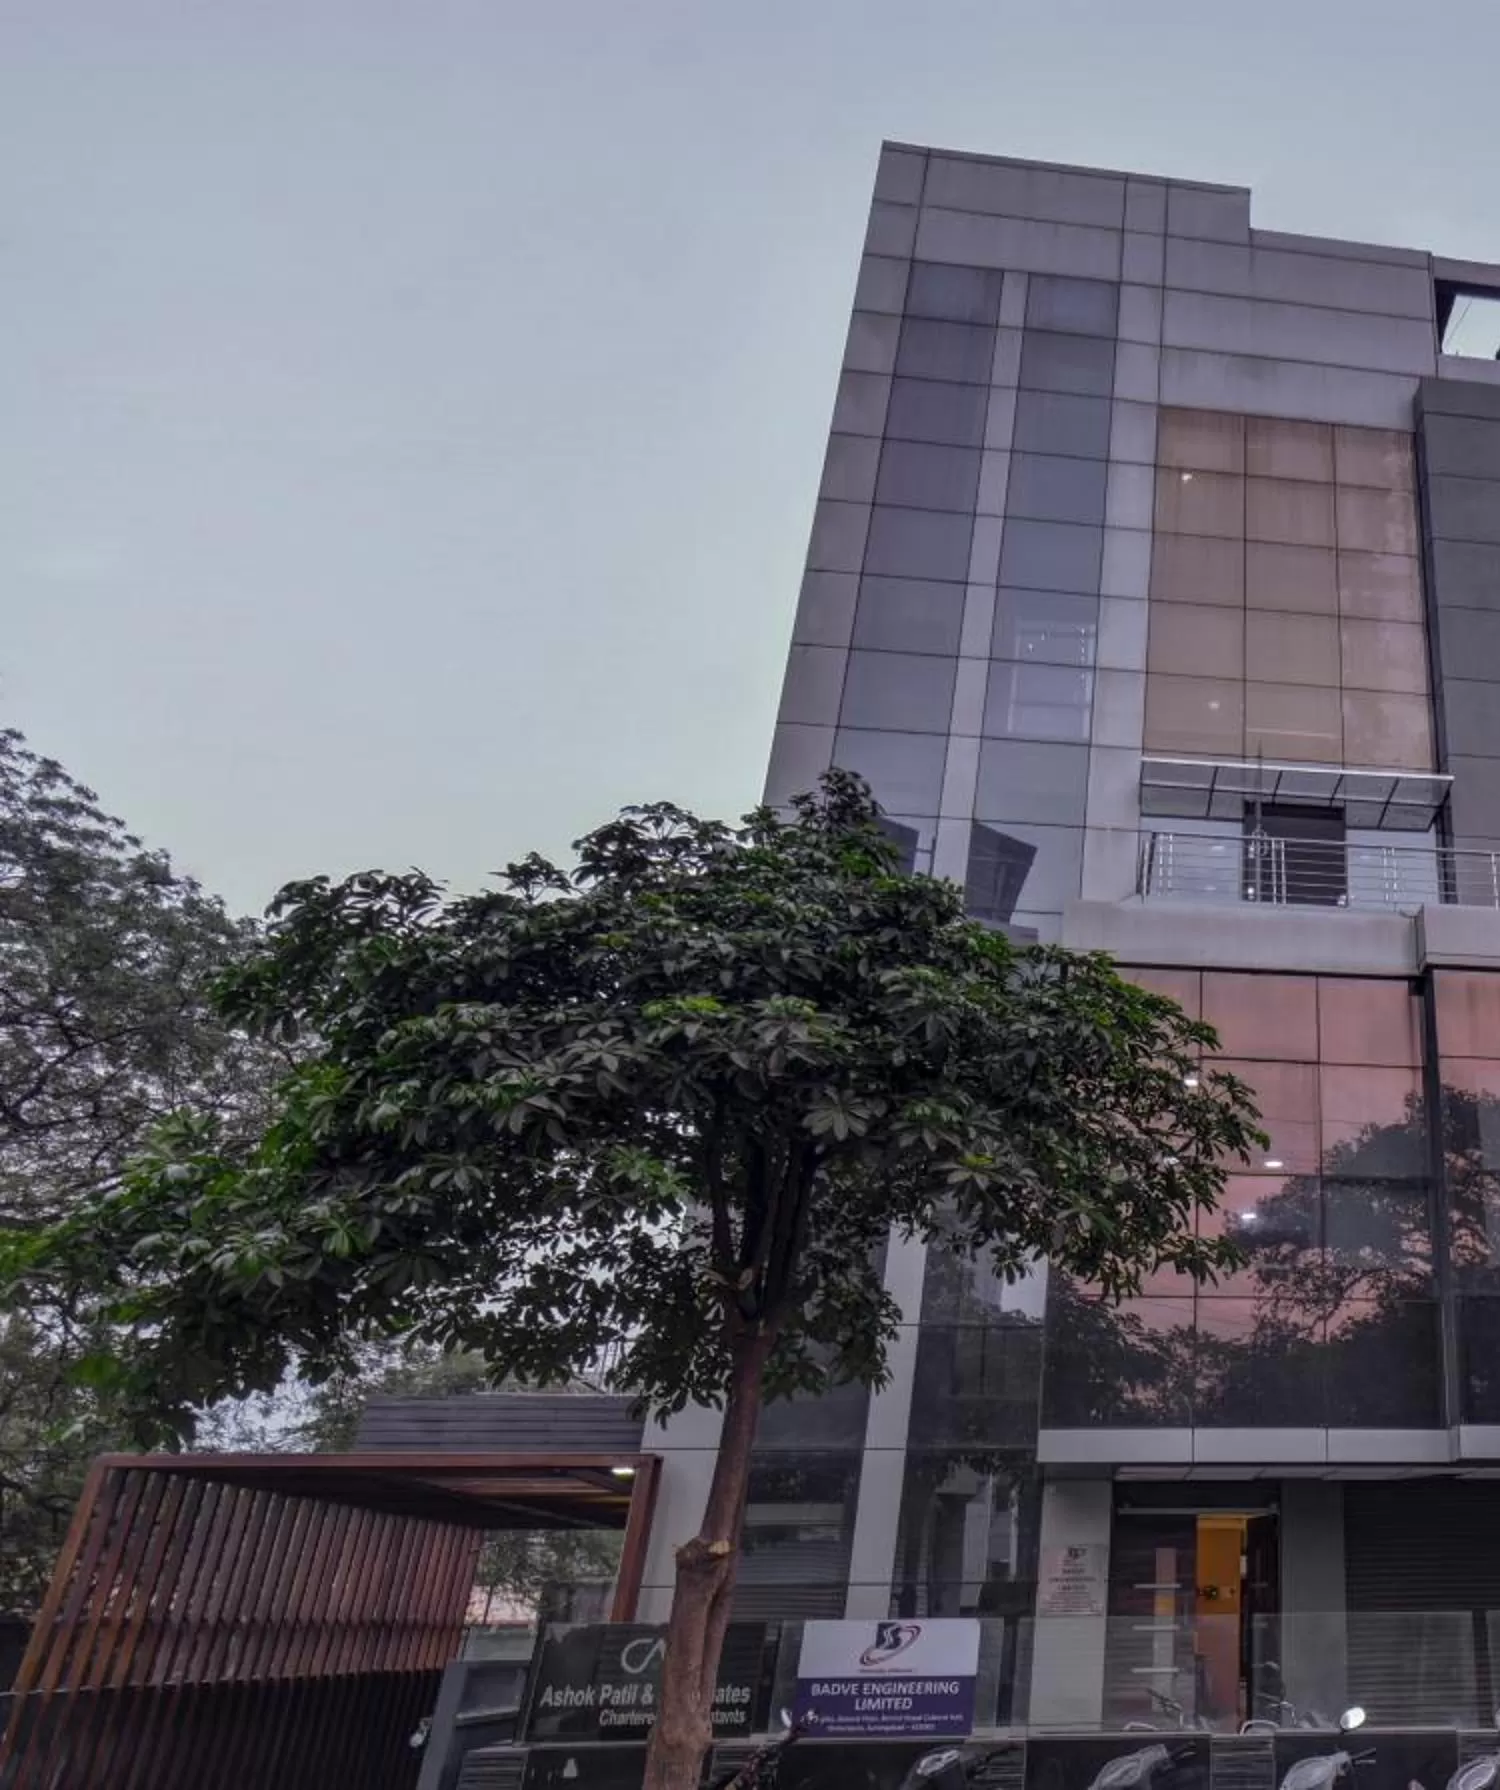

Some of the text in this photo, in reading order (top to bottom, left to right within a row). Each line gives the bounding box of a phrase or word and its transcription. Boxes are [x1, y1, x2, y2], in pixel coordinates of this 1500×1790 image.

[539, 1683, 655, 1708] Ashok Patil &
[811, 1681, 960, 1697] BADVE ENGINEERING
[855, 1697, 913, 1711] LIMITED
[600, 1708, 657, 1727] Chartere
